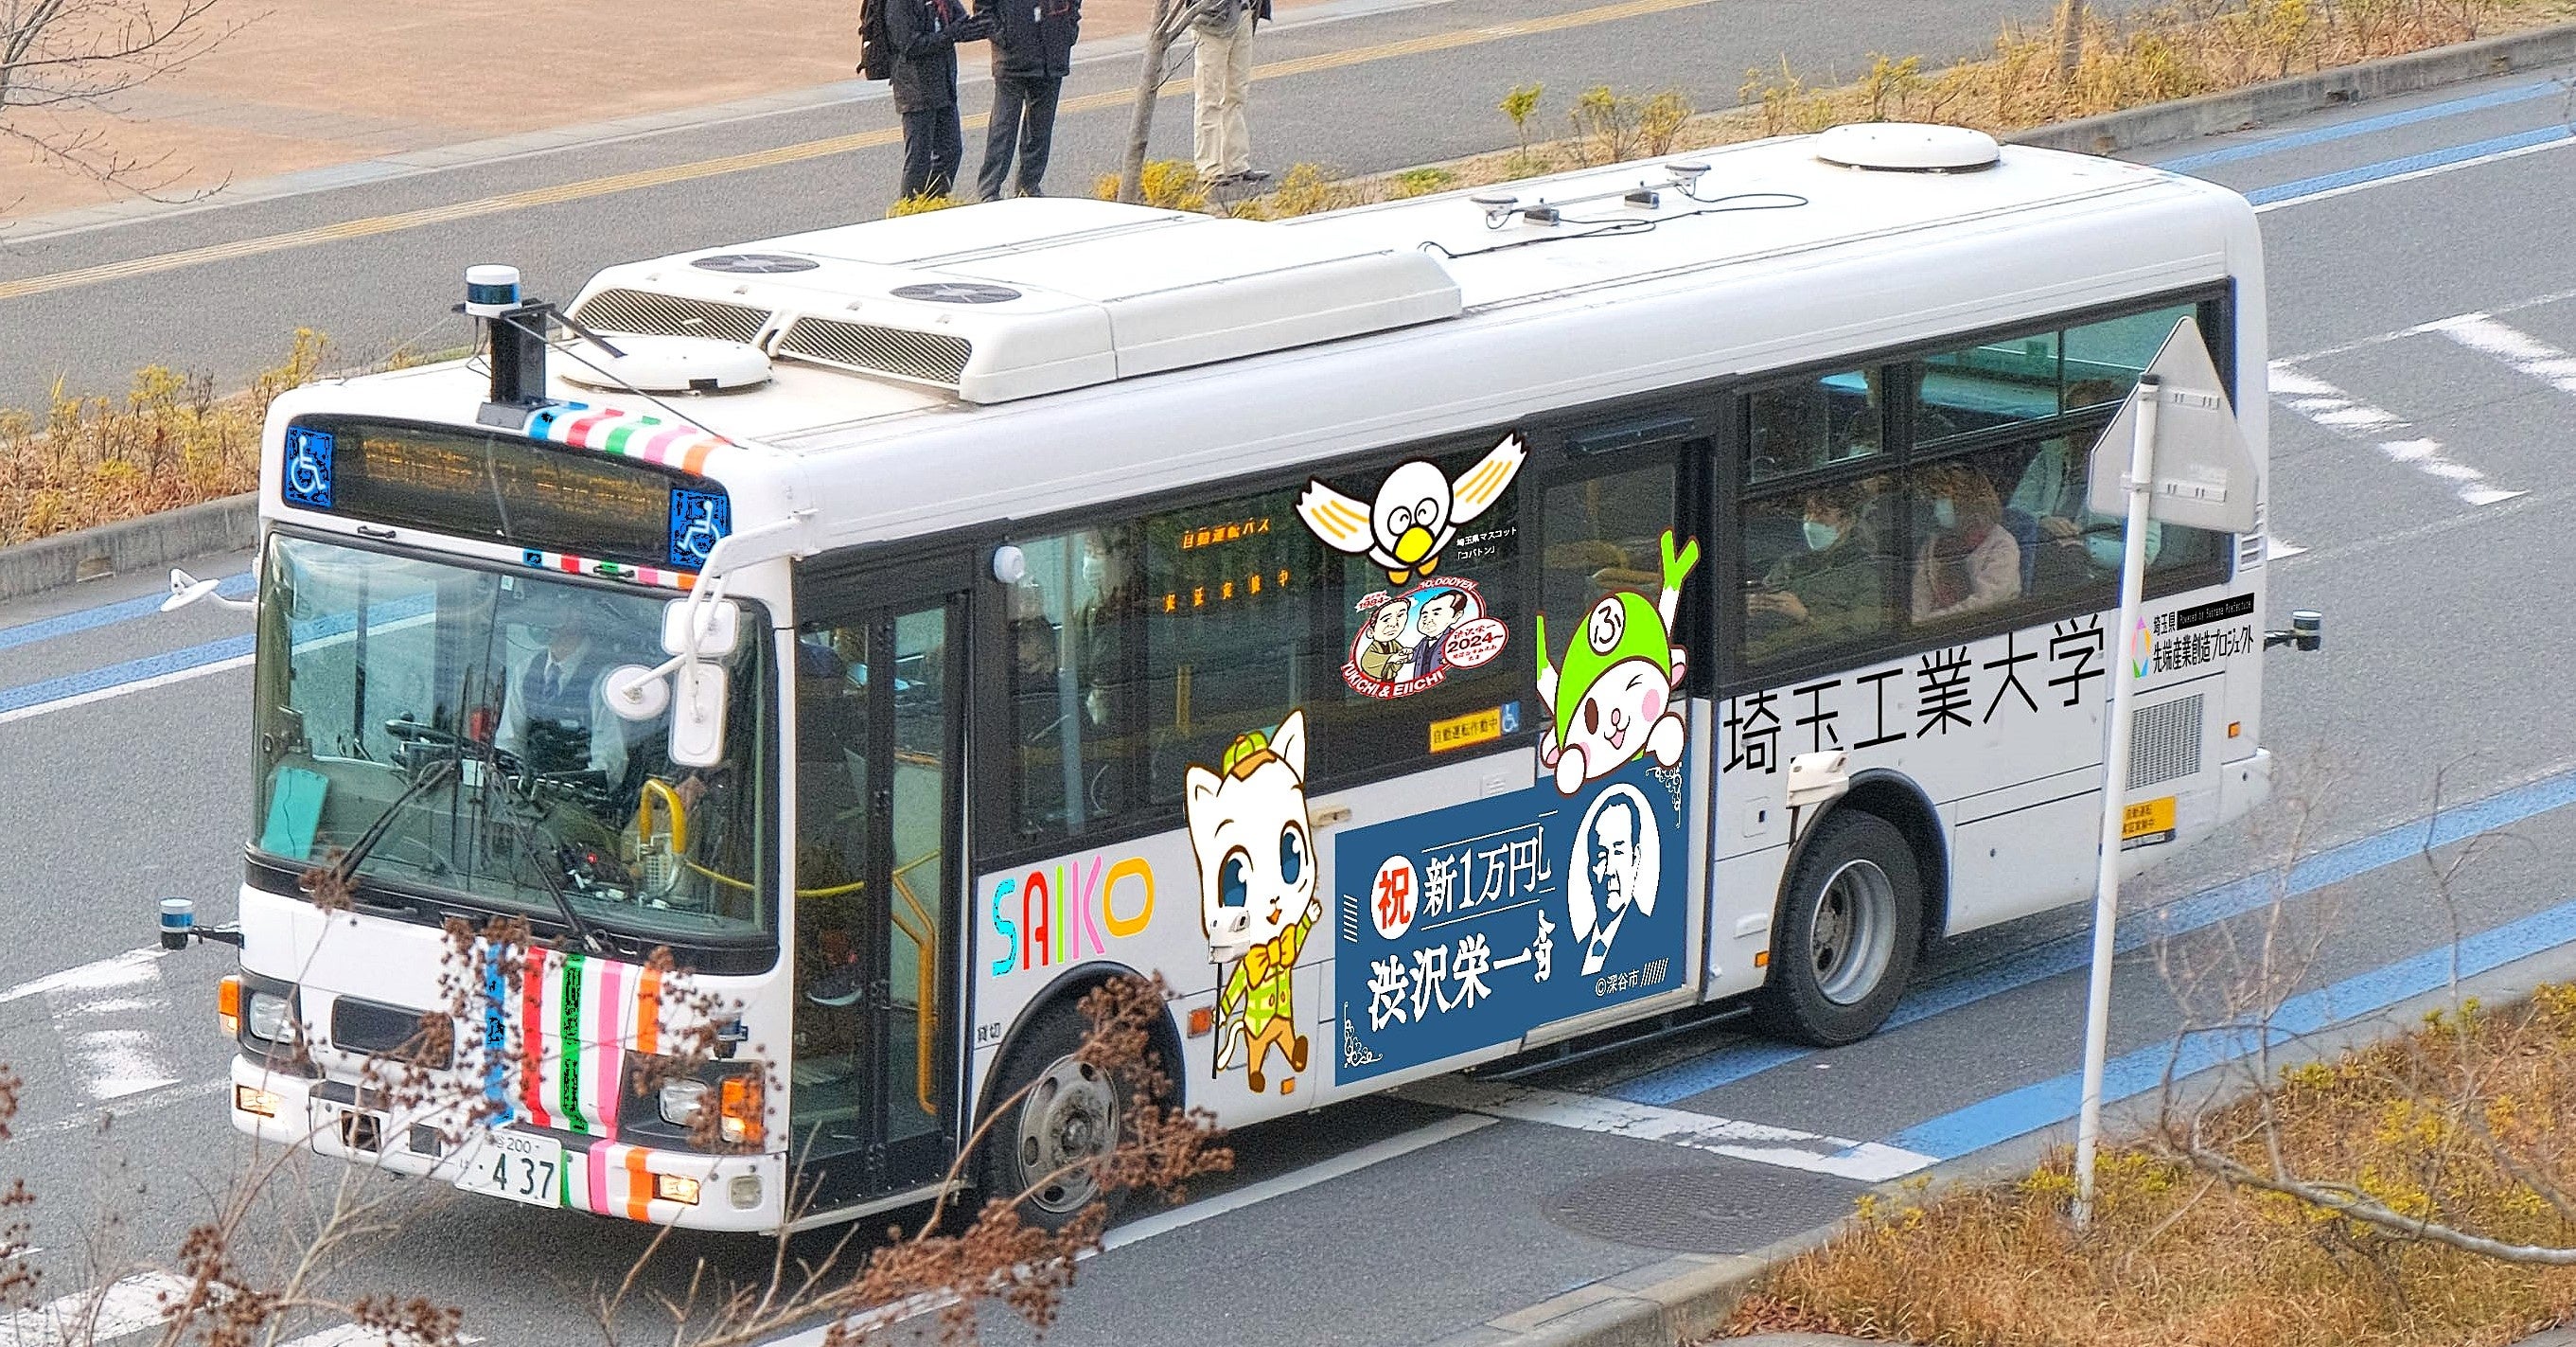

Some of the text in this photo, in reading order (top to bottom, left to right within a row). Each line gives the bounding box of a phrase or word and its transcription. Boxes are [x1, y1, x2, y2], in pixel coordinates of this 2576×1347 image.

[1456, 526, 1517, 547] 埼玉県マスコット
[1594, 605, 1622, 645] ふ
[2153, 611, 2177, 636] 埼玉県
[2153, 624, 2254, 674] 先端産業創造プロジェクト
[1341, 660, 1445, 699] YUKICHI & EIICHI
[1722, 612, 2106, 775] 埼玉工業大学
[992, 854, 1156, 978] SAIKO
[1377, 866, 1412, 930] 祝
